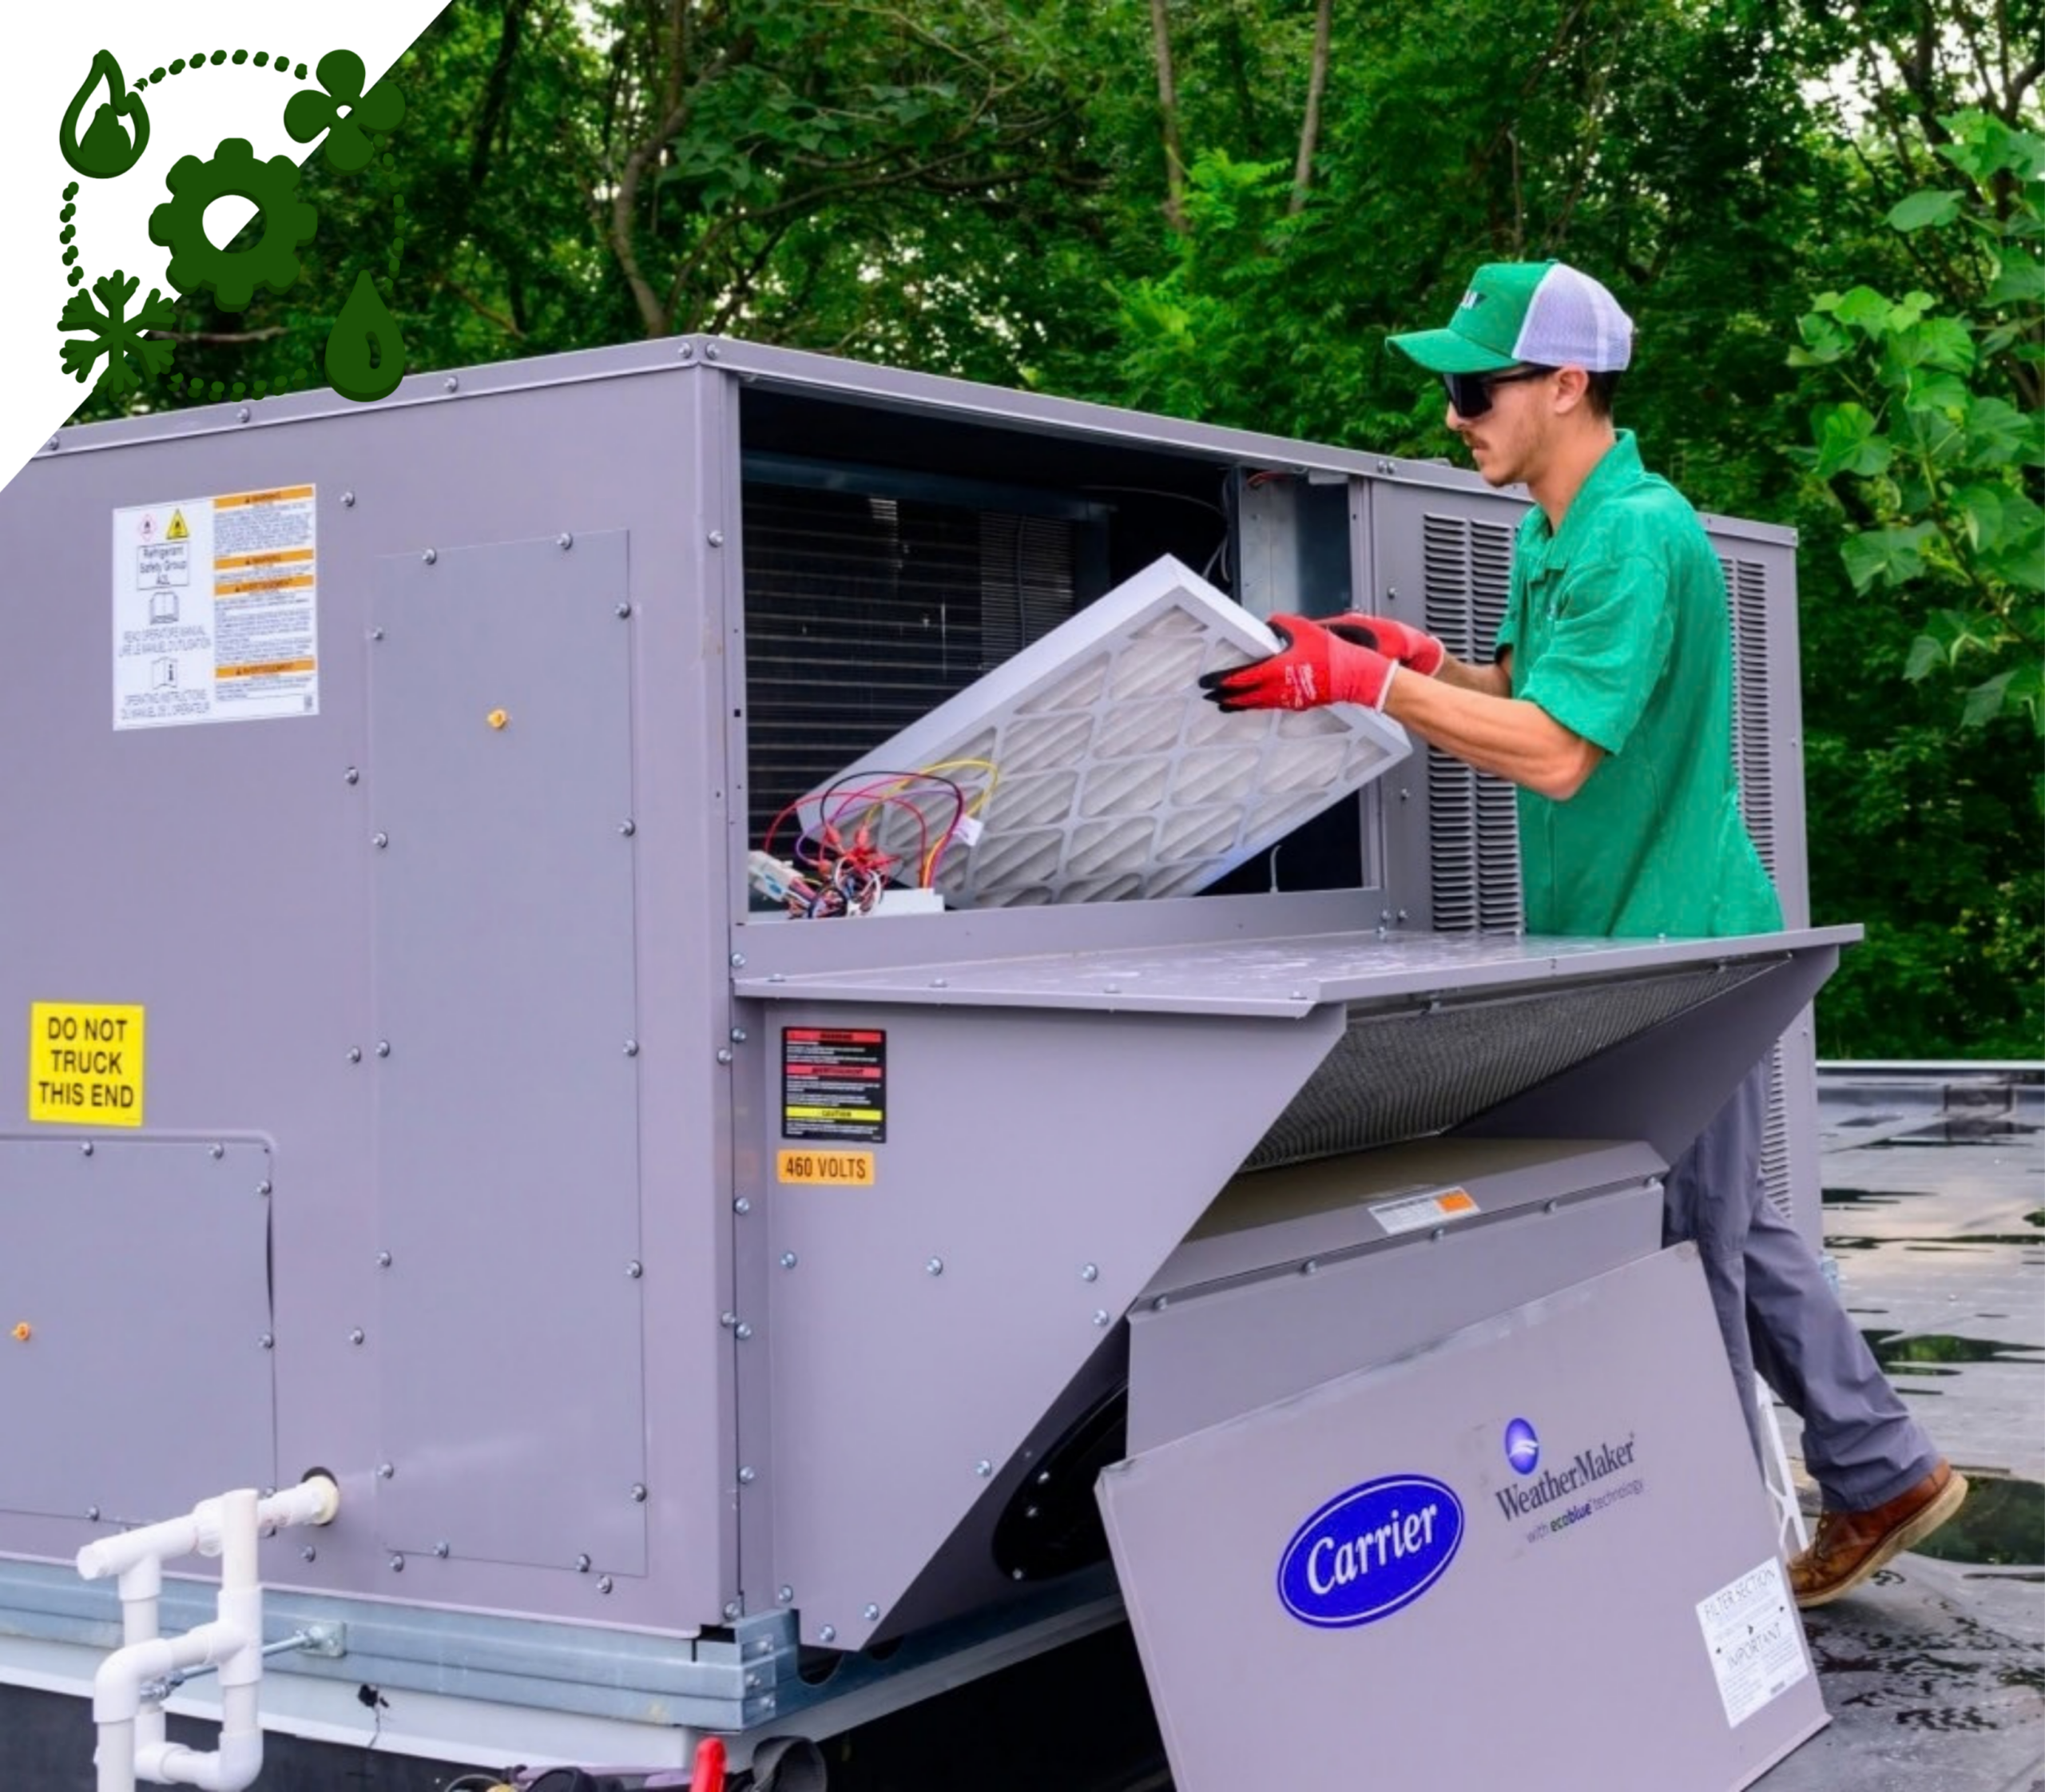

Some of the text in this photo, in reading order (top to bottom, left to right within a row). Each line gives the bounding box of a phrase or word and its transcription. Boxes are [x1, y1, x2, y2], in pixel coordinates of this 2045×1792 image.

[48, 1016, 128, 1042] DO NOT
[51, 1049, 122, 1075] TRUCK
[38, 1081, 133, 1108] THIS END
[786, 1156, 866, 1179] 460 VOLTS
[1527, 1523, 1549, 1544] with
[1593, 1480, 1643, 1511] technology
[1307, 1504, 1438, 1595] Carrier
